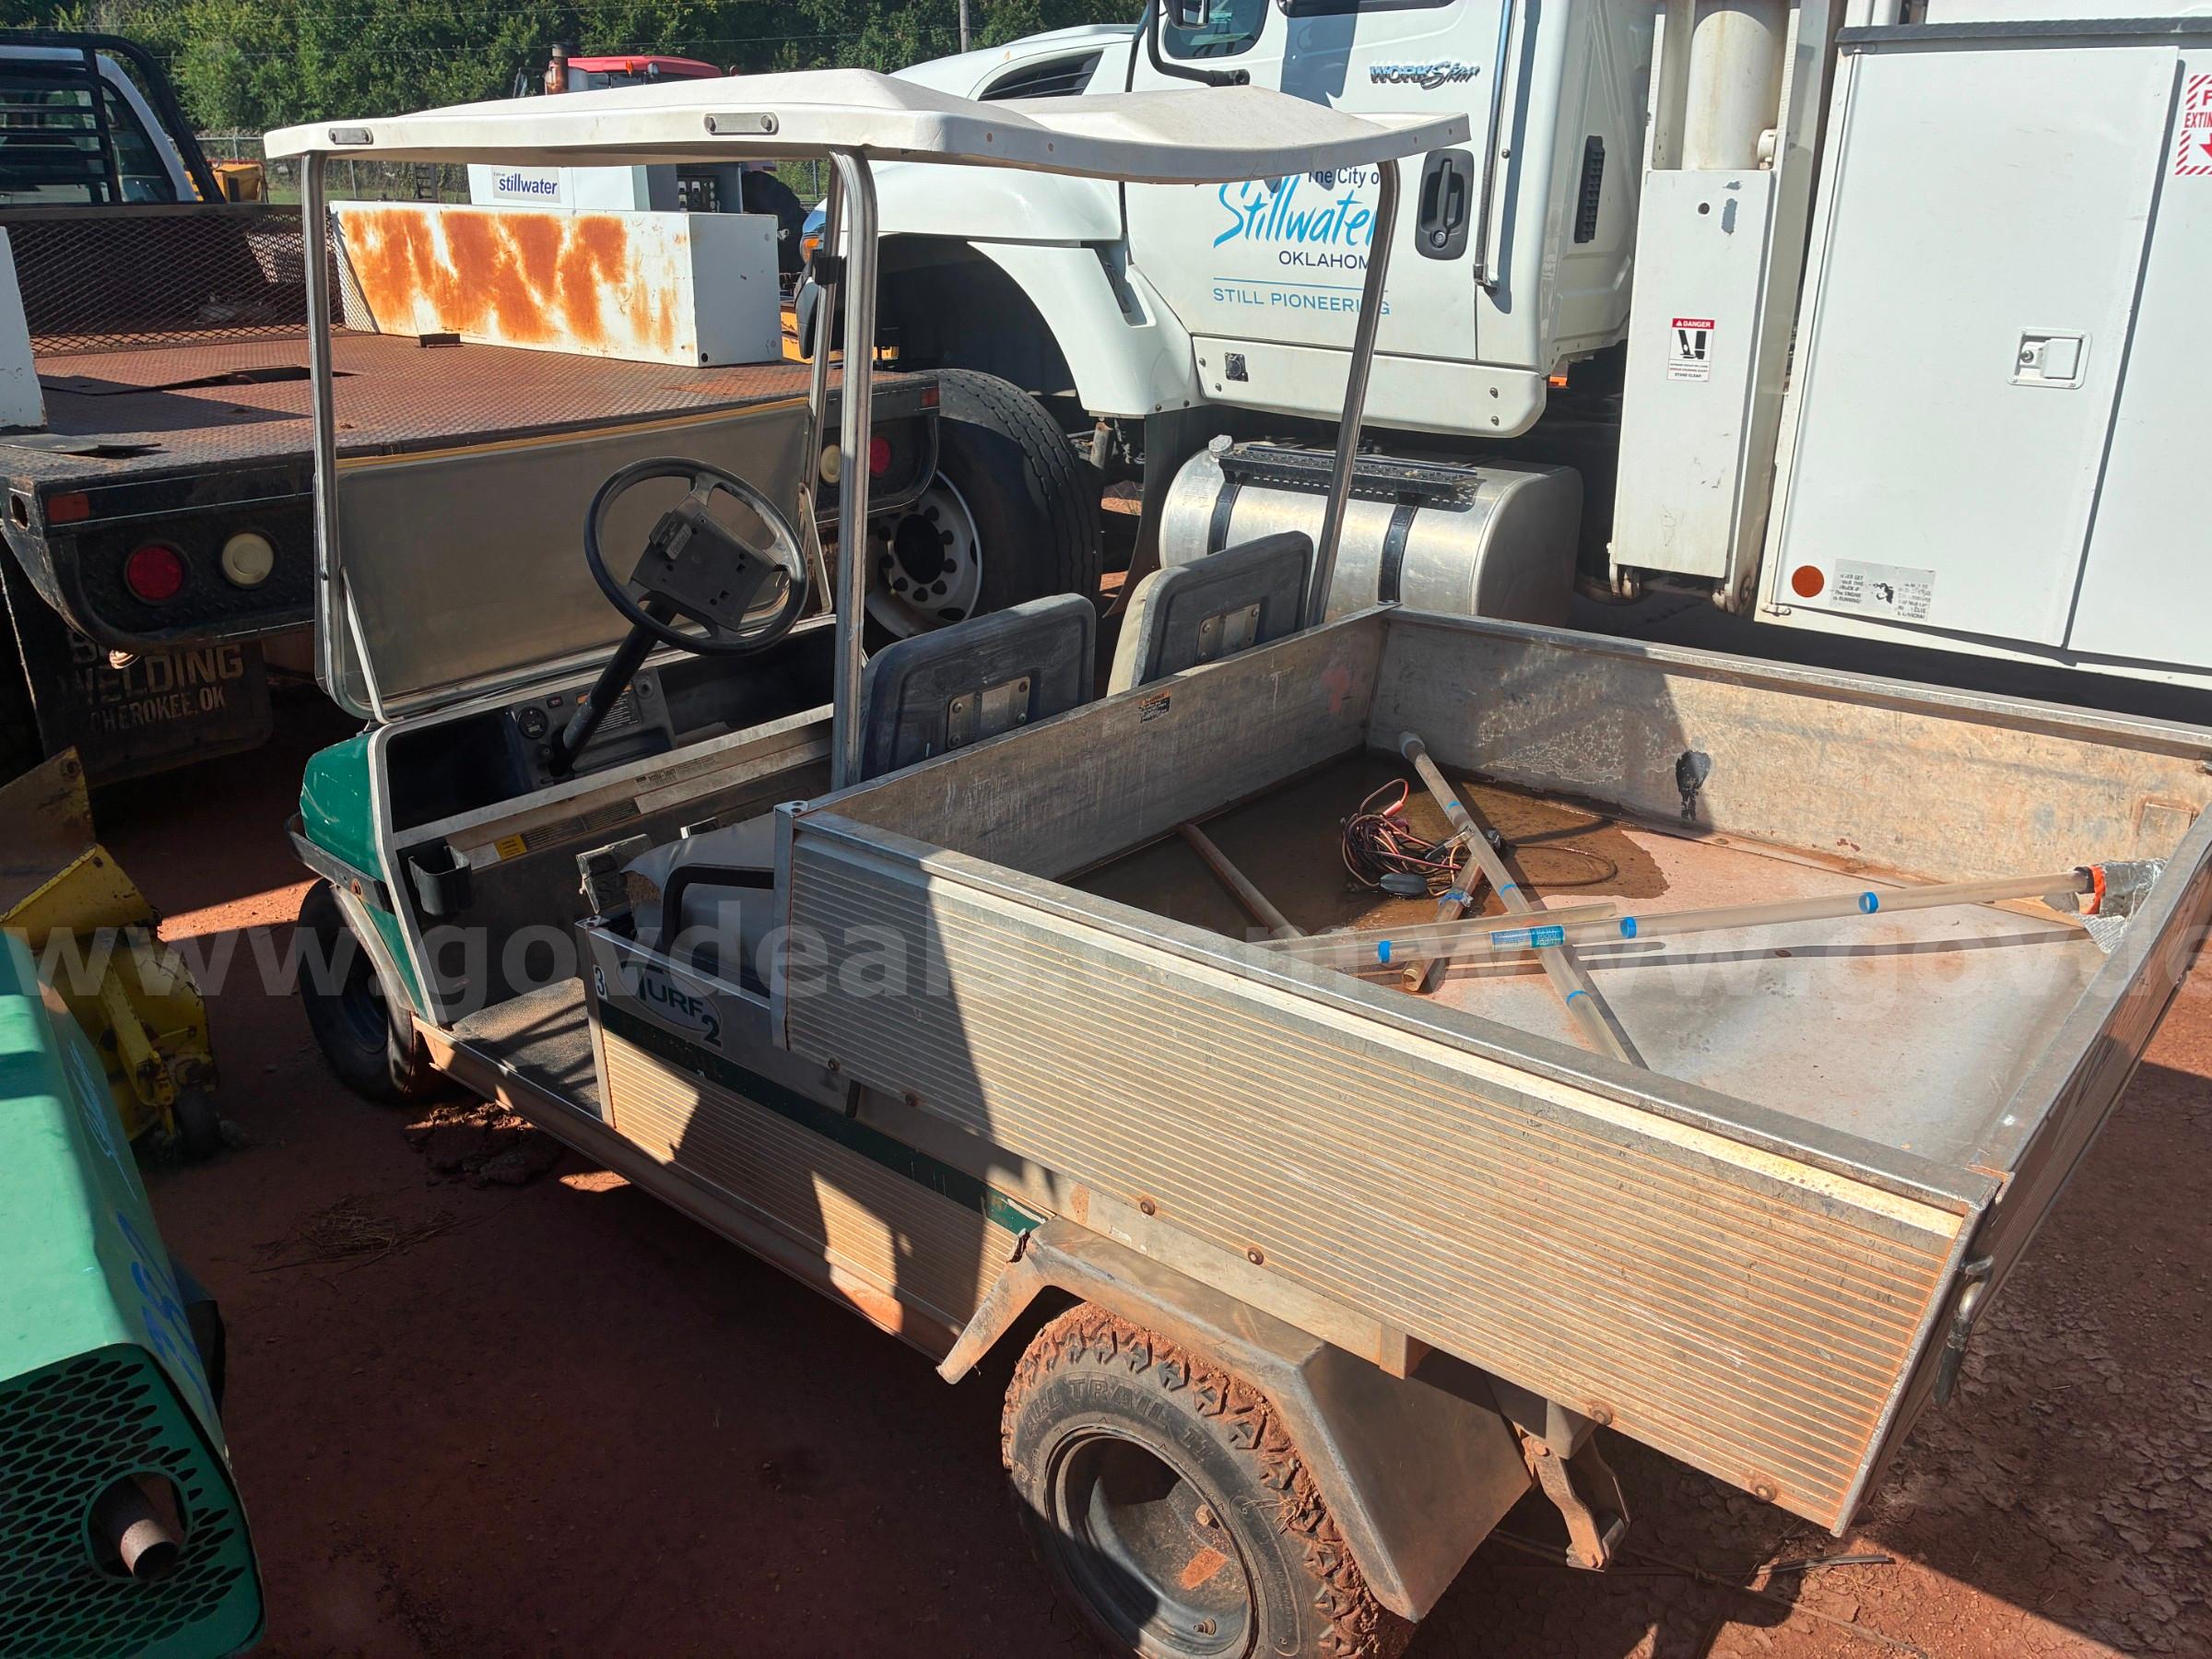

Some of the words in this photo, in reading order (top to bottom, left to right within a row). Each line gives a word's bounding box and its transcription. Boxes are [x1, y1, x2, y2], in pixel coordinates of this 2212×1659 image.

[499, 173, 558, 194] stillwater
[1337, 168, 1367, 188] City
[1371, 172, 1380, 184] o
[1278, 250, 1371, 269] OKLAHOM
[1213, 288, 1265, 305] STILL
[1271, 292, 1391, 315] PIONEERIG
[1683, 320, 1712, 328] DANGER
[199, 687, 226, 712] OK
[594, 966, 606, 997] 3
[620, 959, 704, 1018] TURF
[701, 1014, 723, 1048] 2
[1068, 1379, 1168, 1430] TRAIL
